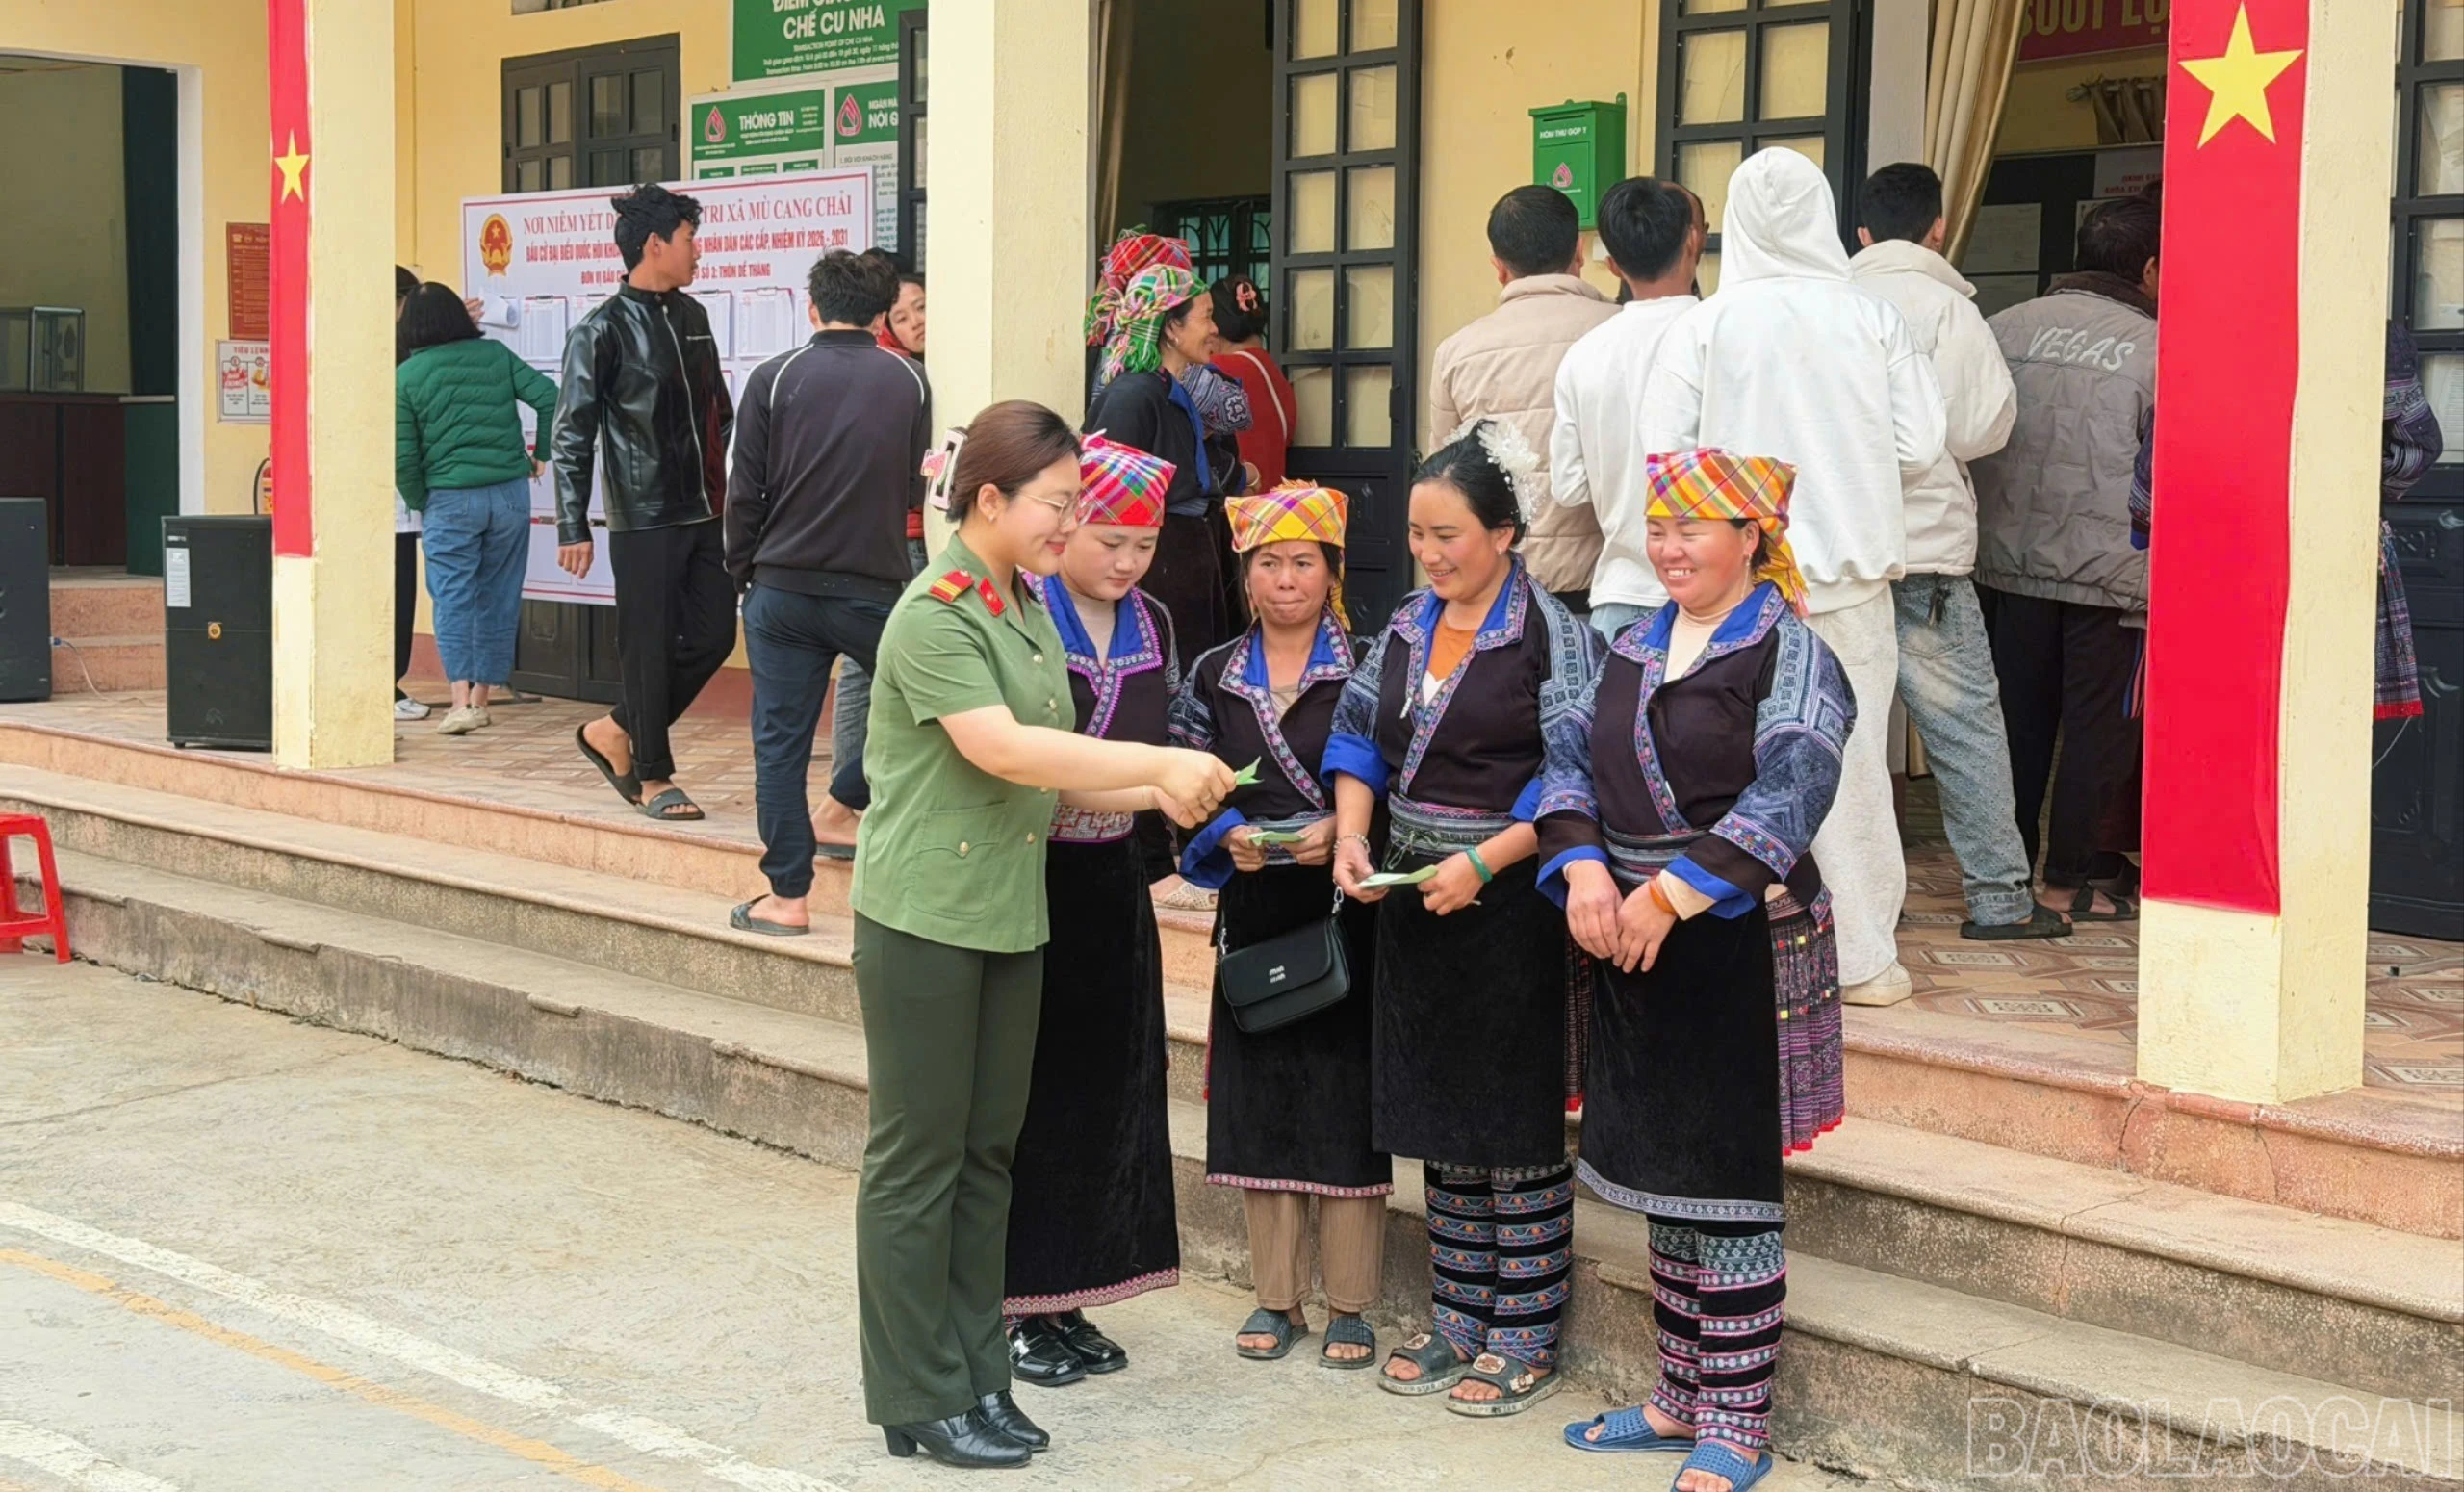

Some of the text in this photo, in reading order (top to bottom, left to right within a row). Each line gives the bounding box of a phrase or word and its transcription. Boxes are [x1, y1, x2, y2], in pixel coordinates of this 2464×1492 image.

[783, 4, 886, 39] CHẾ CU NHA
[738, 111, 777, 131] THÔNG
[778, 110, 794, 126] TIN
[868, 111, 888, 129] NỘI
[524, 215, 544, 235] NƠI
[547, 210, 578, 233] NIÊM
[579, 208, 603, 231] YẾT
[703, 204, 723, 223] TRI
[727, 198, 745, 222] XÃ
[749, 194, 770, 221] MÙ
[773, 196, 813, 219] CANG
[816, 190, 852, 217] CHẢI
[808, 229, 824, 247] 2026
[831, 227, 848, 246] 2031
[2027, 325, 2136, 371] VEGAS
